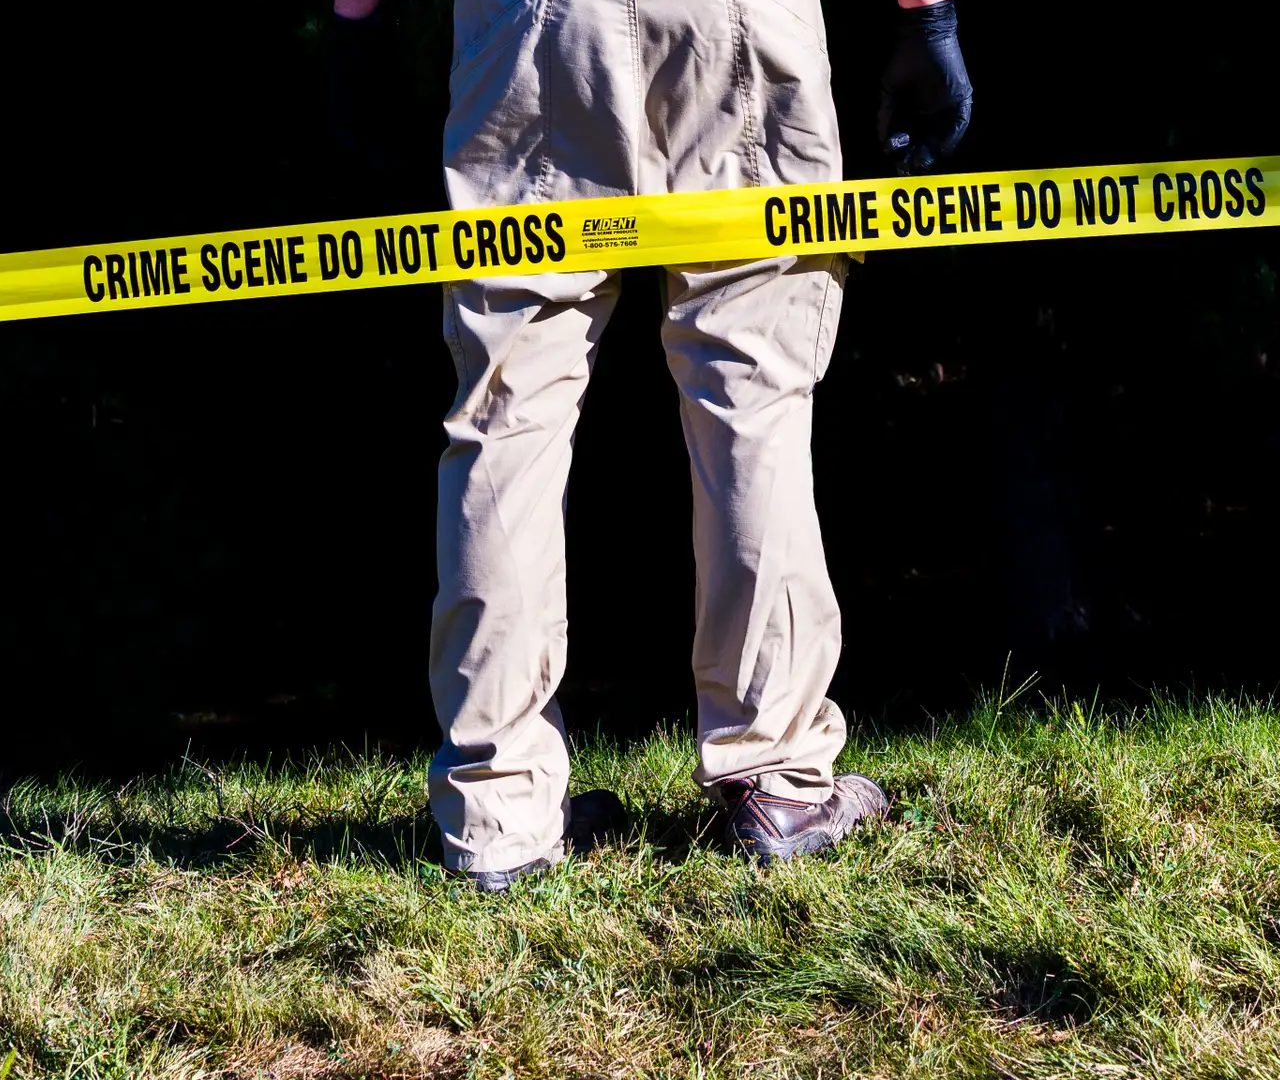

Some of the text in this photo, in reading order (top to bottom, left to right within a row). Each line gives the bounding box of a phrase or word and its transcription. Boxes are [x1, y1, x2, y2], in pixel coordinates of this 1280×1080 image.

[583, 216, 637, 232] EVIDENT
[764, 166, 1266, 246] CRIME SCENE DO NOT CROSS
[83, 212, 566, 303] CRIME SCENE DO NOT CROSS
[584, 240, 638, 249] 1-800-576-7606
